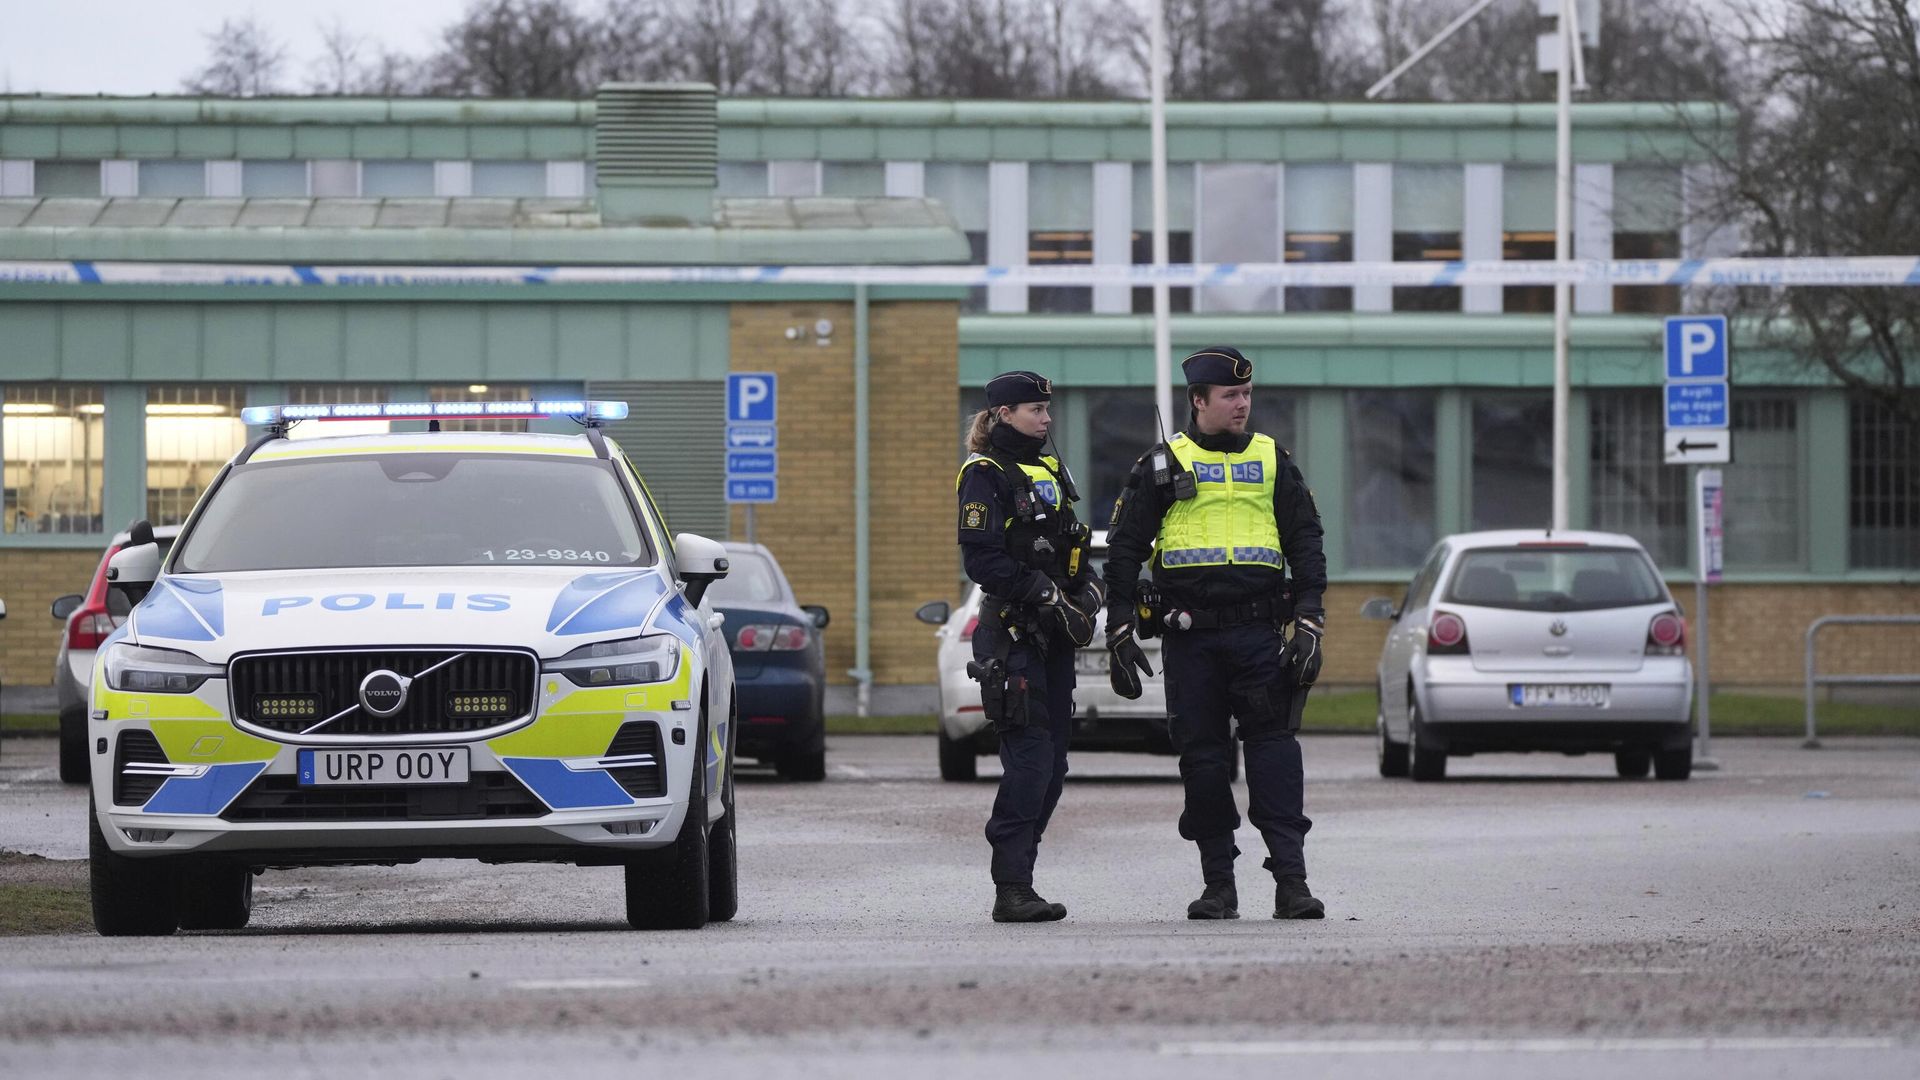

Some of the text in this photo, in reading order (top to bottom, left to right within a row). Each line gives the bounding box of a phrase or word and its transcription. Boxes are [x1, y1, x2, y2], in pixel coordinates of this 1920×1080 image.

[1681, 323, 1716, 374] P
[739, 378, 768, 418] P
[1196, 463, 1261, 480] POLIS
[965, 503, 986, 511] POLIS
[483, 549, 610, 562] 1 23-9340
[261, 592, 512, 616] POLIS
[326, 753, 384, 780] URP
